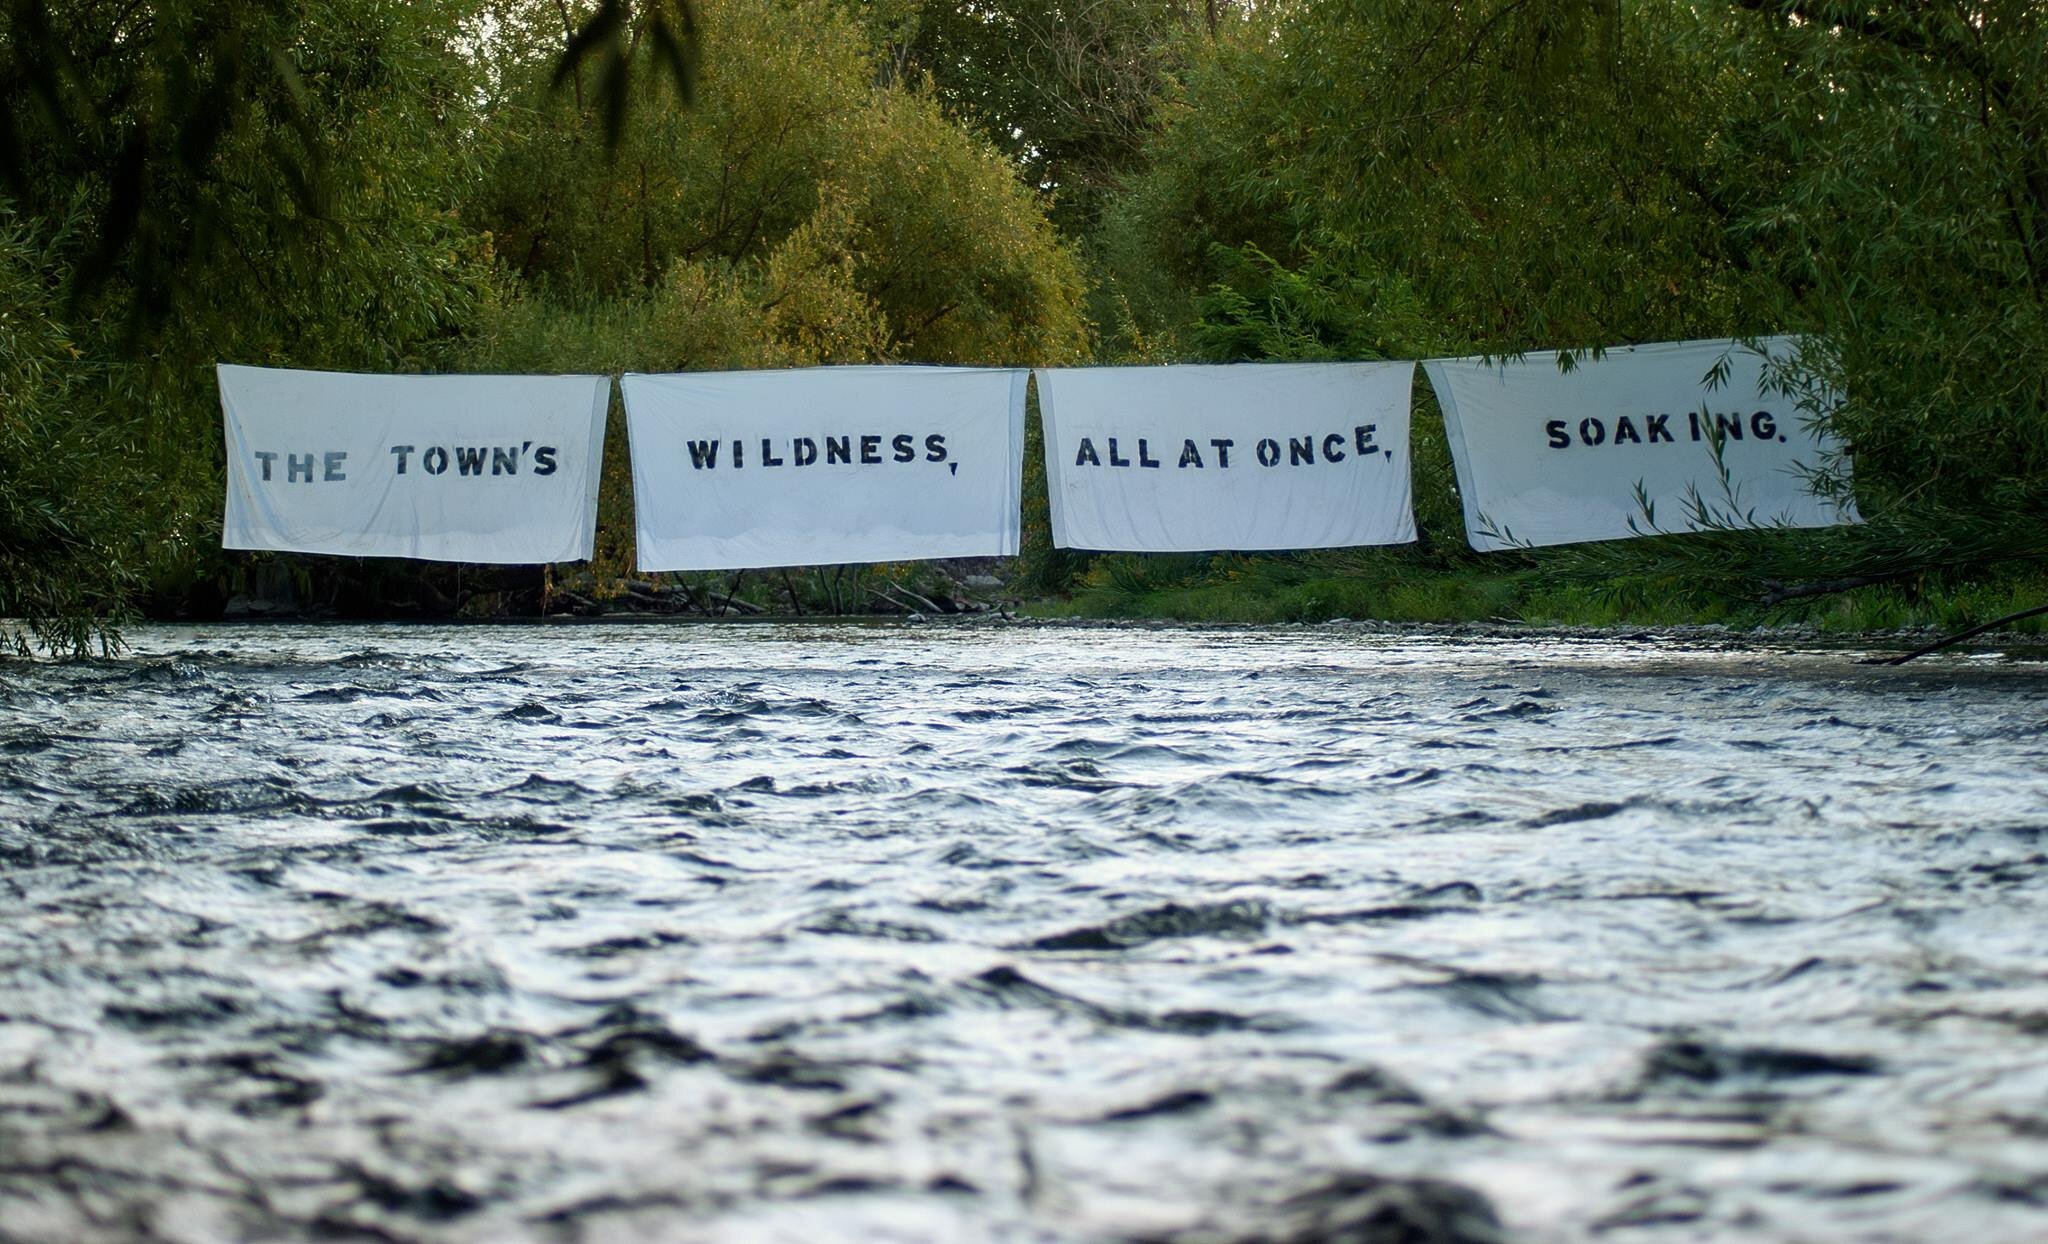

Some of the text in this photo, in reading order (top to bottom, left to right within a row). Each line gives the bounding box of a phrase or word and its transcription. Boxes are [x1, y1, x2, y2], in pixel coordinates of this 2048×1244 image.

[1075, 423, 1393, 469] ALL AT ONCE,
[1545, 410, 1787, 449] SOAKING.
[254, 440, 559, 484] THE TOWN'S
[686, 433, 959, 476] WILDNESS,
